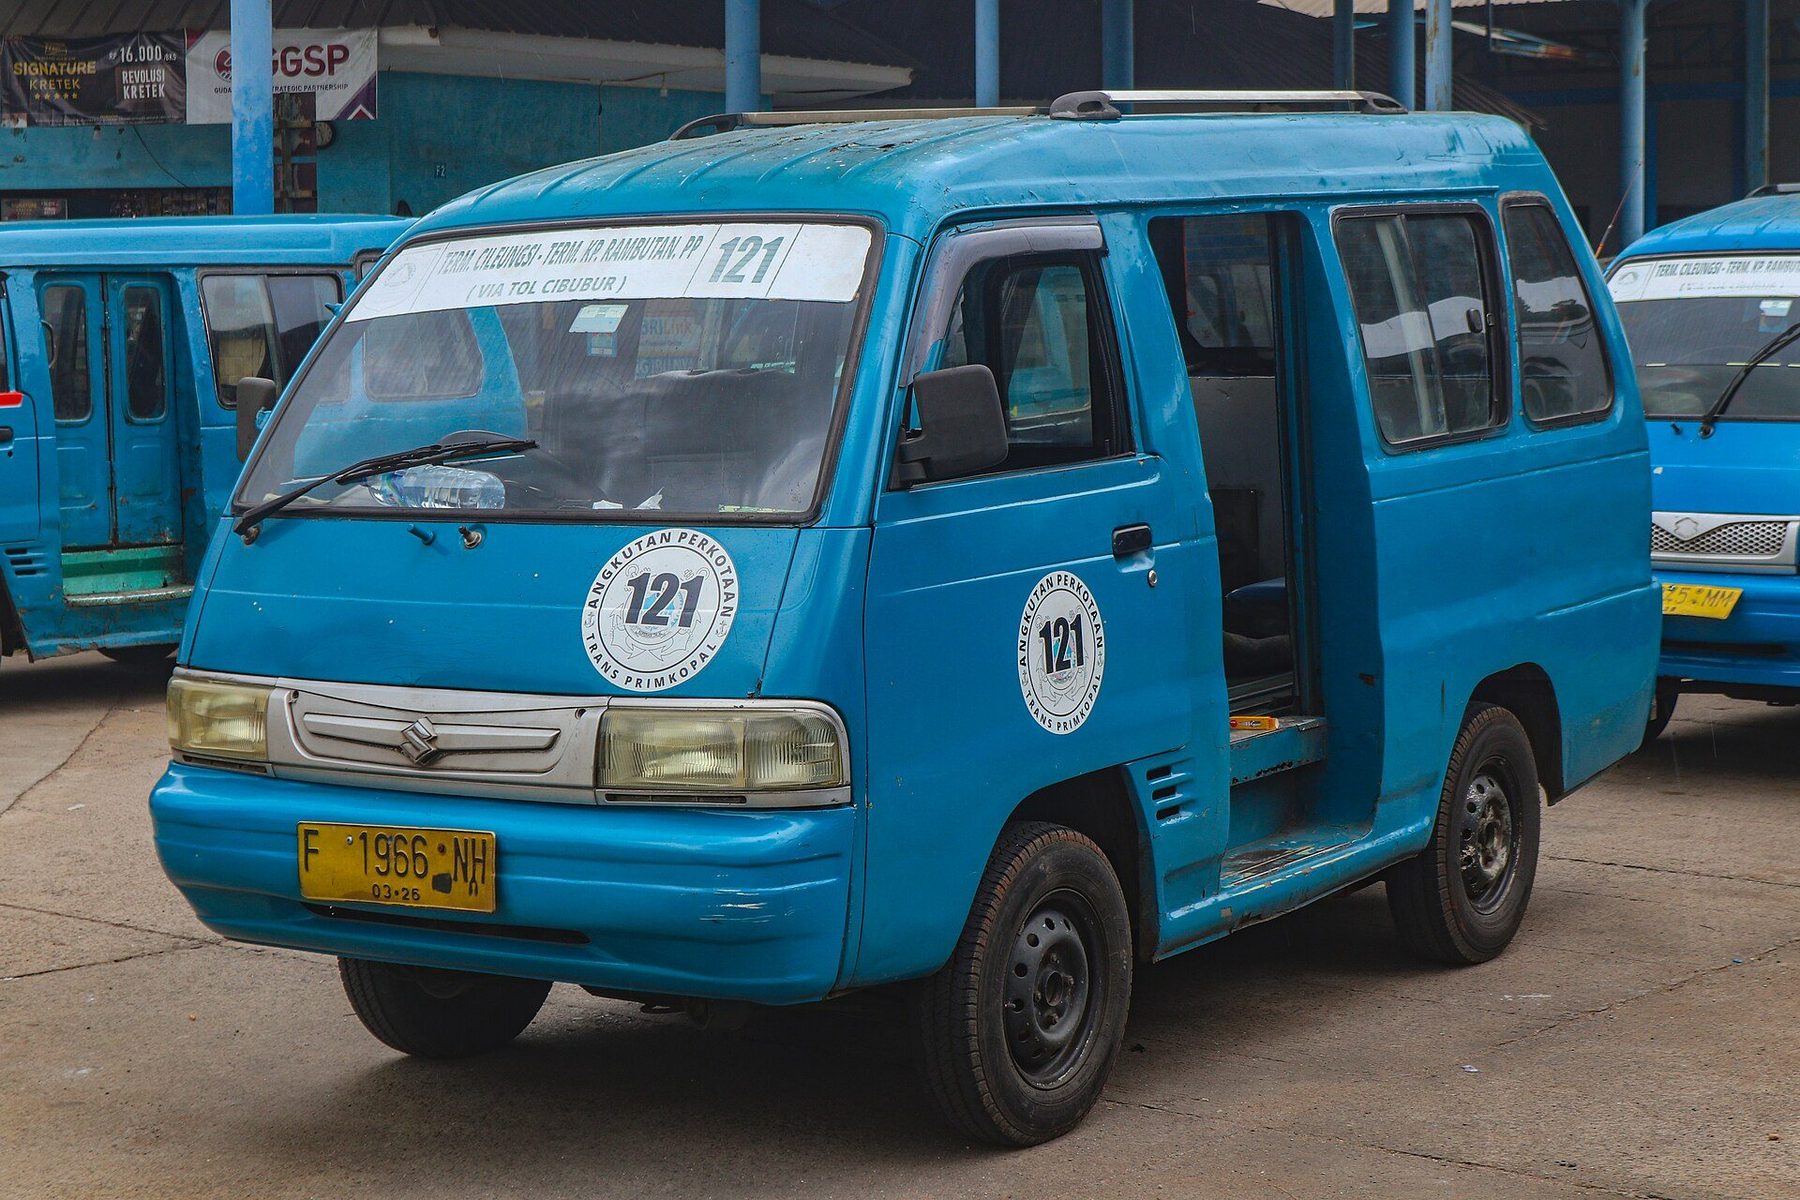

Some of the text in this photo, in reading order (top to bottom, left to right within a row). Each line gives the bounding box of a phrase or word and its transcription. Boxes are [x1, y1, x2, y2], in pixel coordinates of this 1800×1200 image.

[13, 61, 96, 76] SIGNATURE
[119, 45, 162, 63] 16.000
[272, 44, 349, 77] GSP
[29, 78, 81, 90] KRETEK
[122, 68, 166, 85] REVOLUSI
[123, 84, 165, 100] KRETEK
[303, 83, 349, 92] PARTNERSHIP
[438, 249, 476, 275] TERM.
[474, 244, 542, 271] CILEUNGSI
[543, 240, 584, 266] TERM.
[679, 235, 704, 259] PP
[708, 235, 785, 284] 121
[1680, 261, 1722, 275] CILEUNGSI
[508, 280, 537, 296] TOL
[588, 531, 736, 618] ANGKUTAN PERKOTAAN
[625, 572, 705, 628] 121
[1019, 574, 1103, 667] ANGKUTAN PERKOTAAN
[586, 632, 717, 689] TRANS PRIMKOPAL
[1039, 613, 1085, 675] 121
[1025, 674, 1101, 731] TRANS PRIMKOPAL
[303, 828, 487, 884] F 1966 NH
